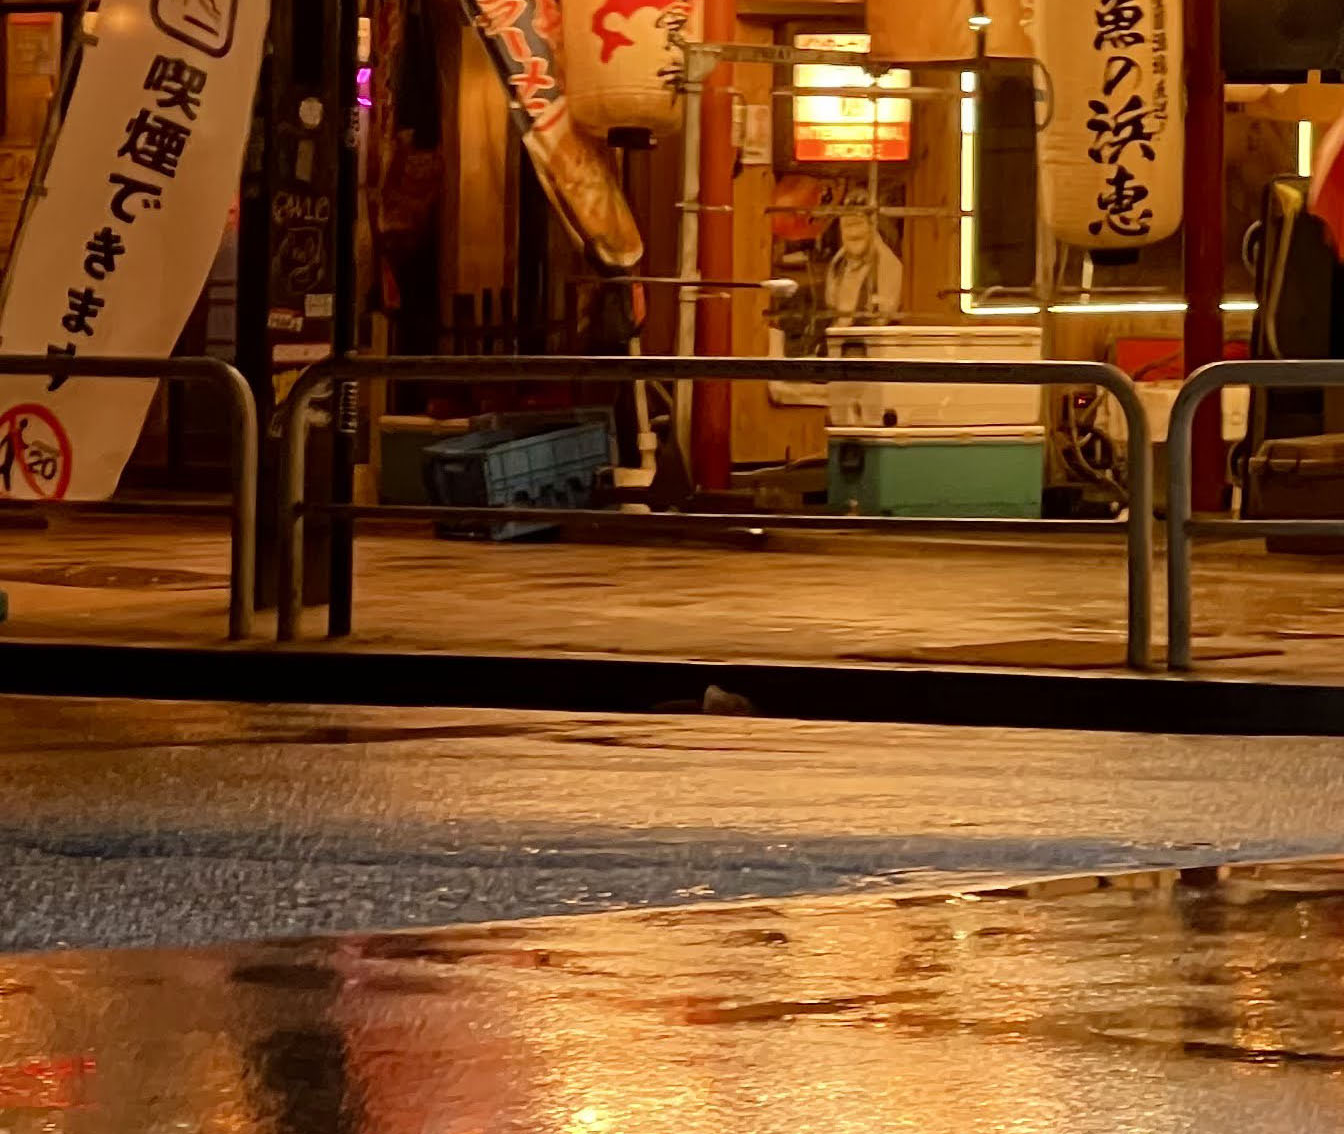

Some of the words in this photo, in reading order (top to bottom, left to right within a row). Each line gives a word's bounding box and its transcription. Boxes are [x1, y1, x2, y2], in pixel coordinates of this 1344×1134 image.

[43, 53, 209, 393] 喫煙できます
